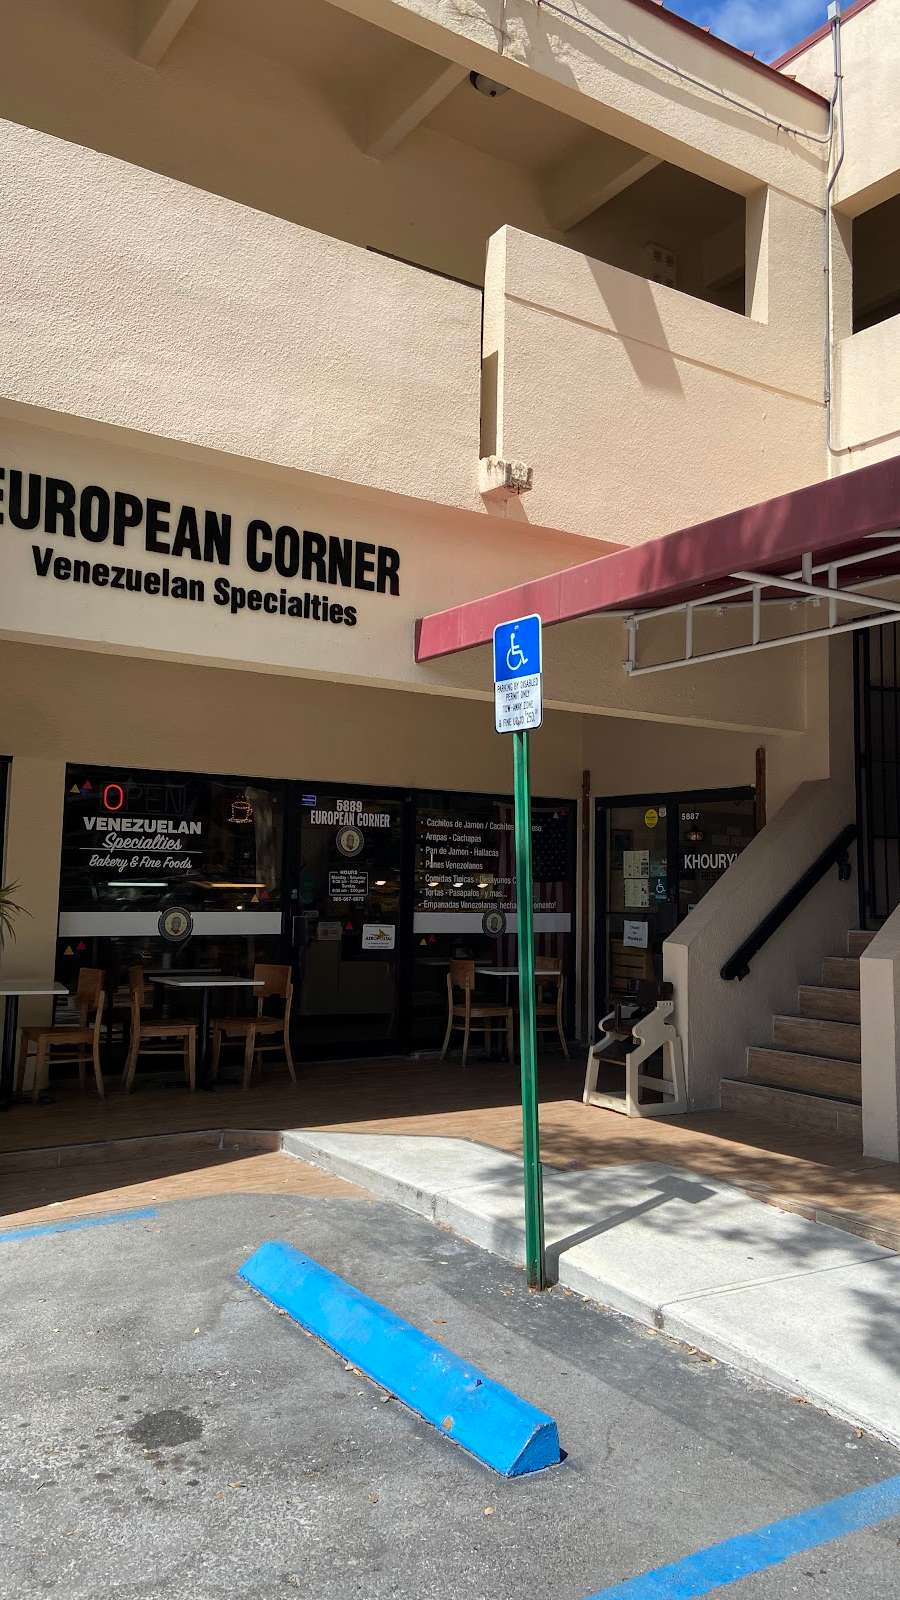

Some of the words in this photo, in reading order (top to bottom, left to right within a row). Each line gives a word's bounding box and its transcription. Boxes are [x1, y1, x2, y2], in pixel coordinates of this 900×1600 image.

[0, 467, 232, 566] UROPEAN
[246, 519, 401, 596] CORNER
[32, 545, 204, 602] Venezuelan
[214, 576, 358, 626] Specialties
[520, 677, 538, 689] DISABLED
[336, 800, 363, 812] 5889
[310, 810, 355, 826] EUROPEAN
[356, 813, 391, 828] CORNER
[681, 812, 700, 821] 5887
[82, 816, 202, 835] VENEZUELAN
[426, 818, 454, 828] Cachitos
[454, 820, 463, 828] de
[464, 821, 484, 829] Jamon
[102, 832, 183, 852] Specialties
[452, 834, 482, 844] Cachapas
[425, 846, 438, 855] Pan
[438, 847, 447, 855] de
[473, 848, 499, 857] Hallacas
[89, 855, 128, 872] Bakery
[130, 856, 138, 867] &
[139, 856, 161, 868] Fine
[163, 857, 192, 869] Foods
[423, 900, 460, 910] Empanadas
[460, 901, 498, 909] Venezolanas
